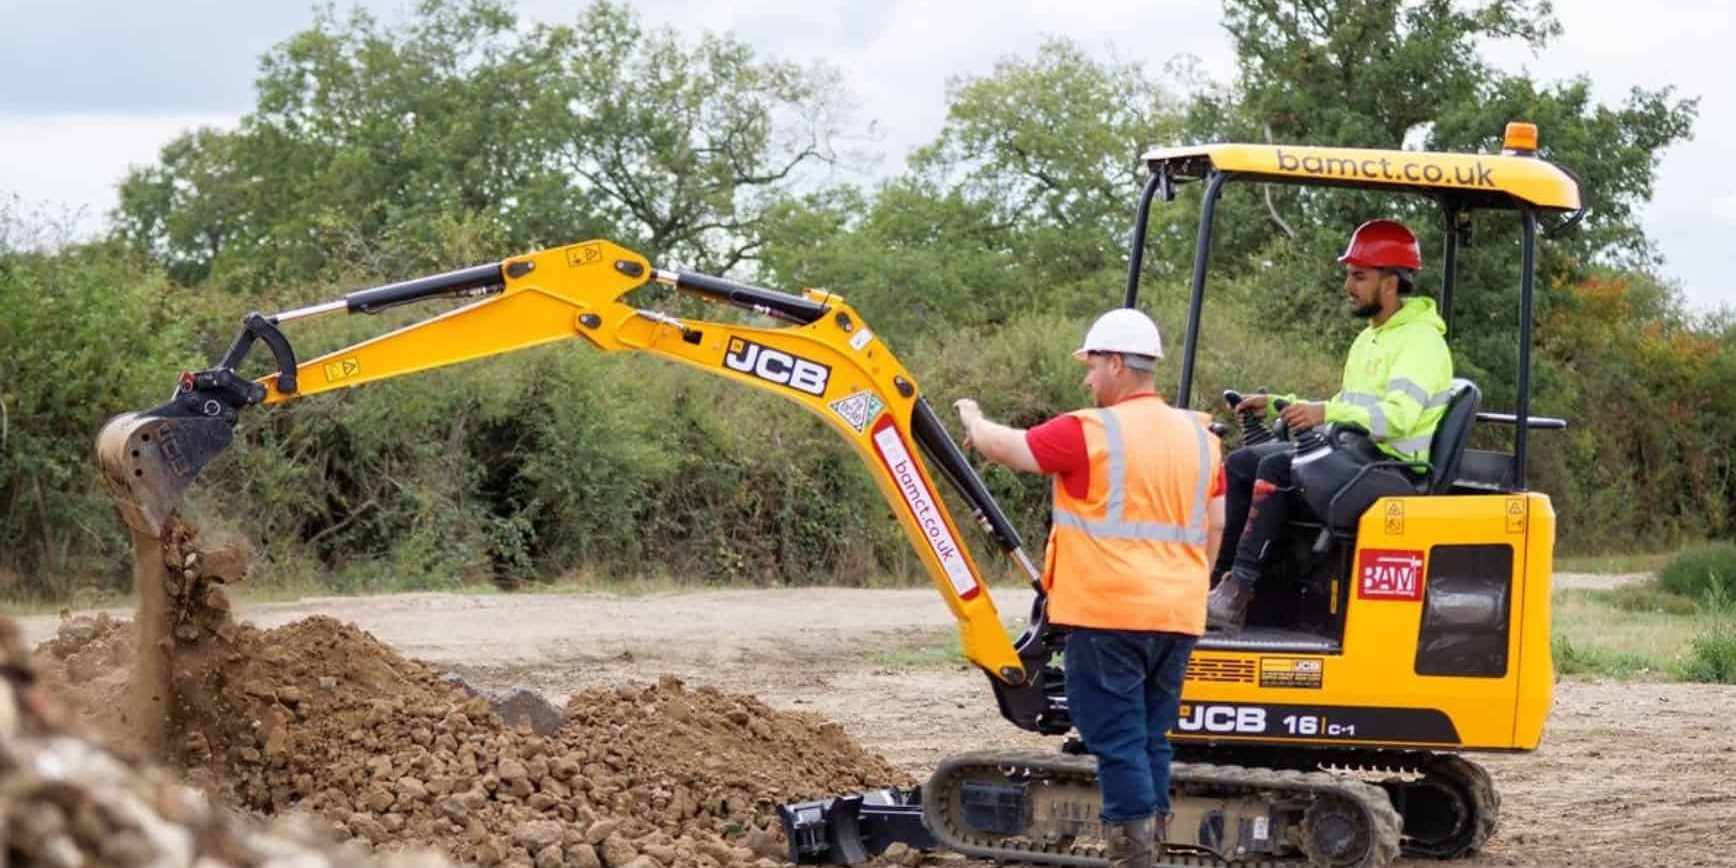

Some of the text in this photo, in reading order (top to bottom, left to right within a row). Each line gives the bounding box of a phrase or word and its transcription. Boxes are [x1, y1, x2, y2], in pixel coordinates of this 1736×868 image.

[1277, 149, 1495, 187] bamct.co.uk
[726, 343, 829, 395] JCB
[894, 459, 955, 562] bamct.co.uk
[1364, 566, 1415, 590] BAM
[1178, 704, 1266, 732] JCB
[1283, 715, 1319, 735] 16
